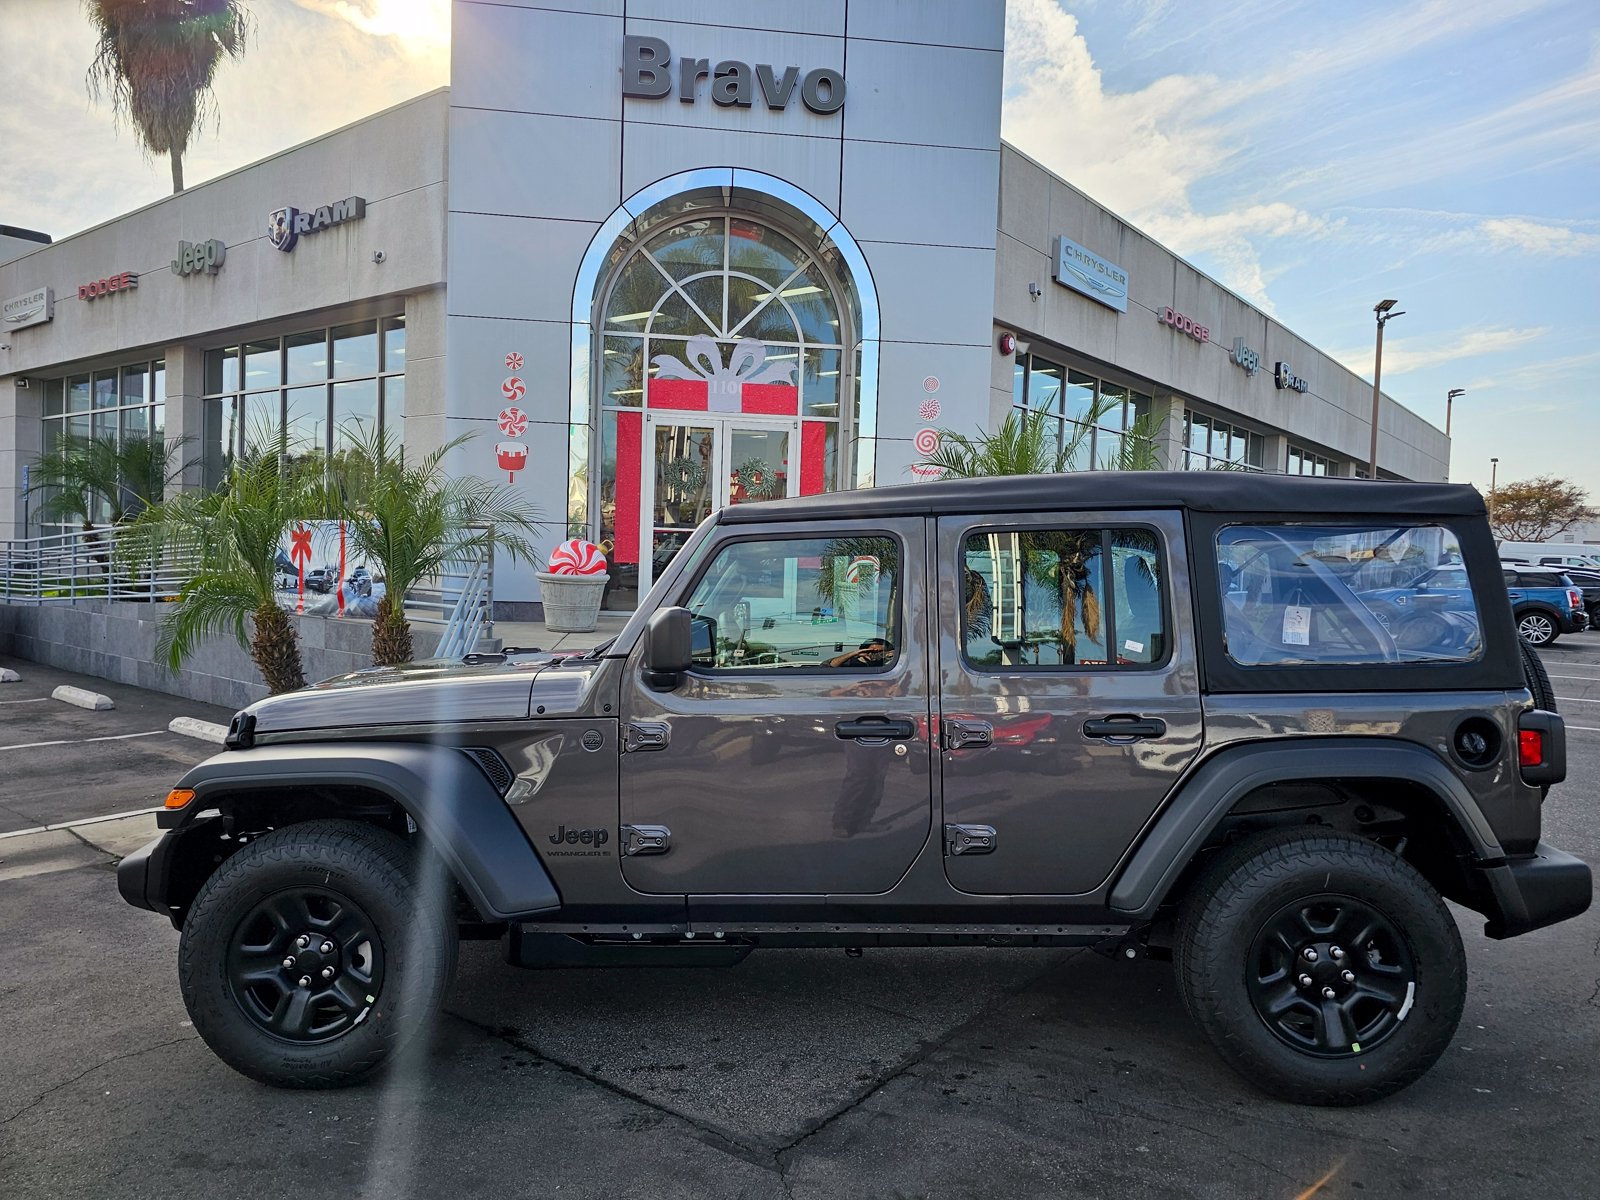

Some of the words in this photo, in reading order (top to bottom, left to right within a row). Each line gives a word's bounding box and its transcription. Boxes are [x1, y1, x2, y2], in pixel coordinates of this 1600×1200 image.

[622, 34, 847, 115] Bravo
[294, 196, 365, 236] RAM
[171, 239, 225, 277] Jeep
[1064, 245, 1126, 286] CHRYSLER
[4, 292, 45, 312] CHRYSLER
[79, 271, 135, 301] DODGE
[1163, 306, 1210, 343] DODGE
[1233, 337, 1259, 376] Jeep
[1288, 373, 1309, 393] RAM
[548, 824, 609, 848] Jeep
